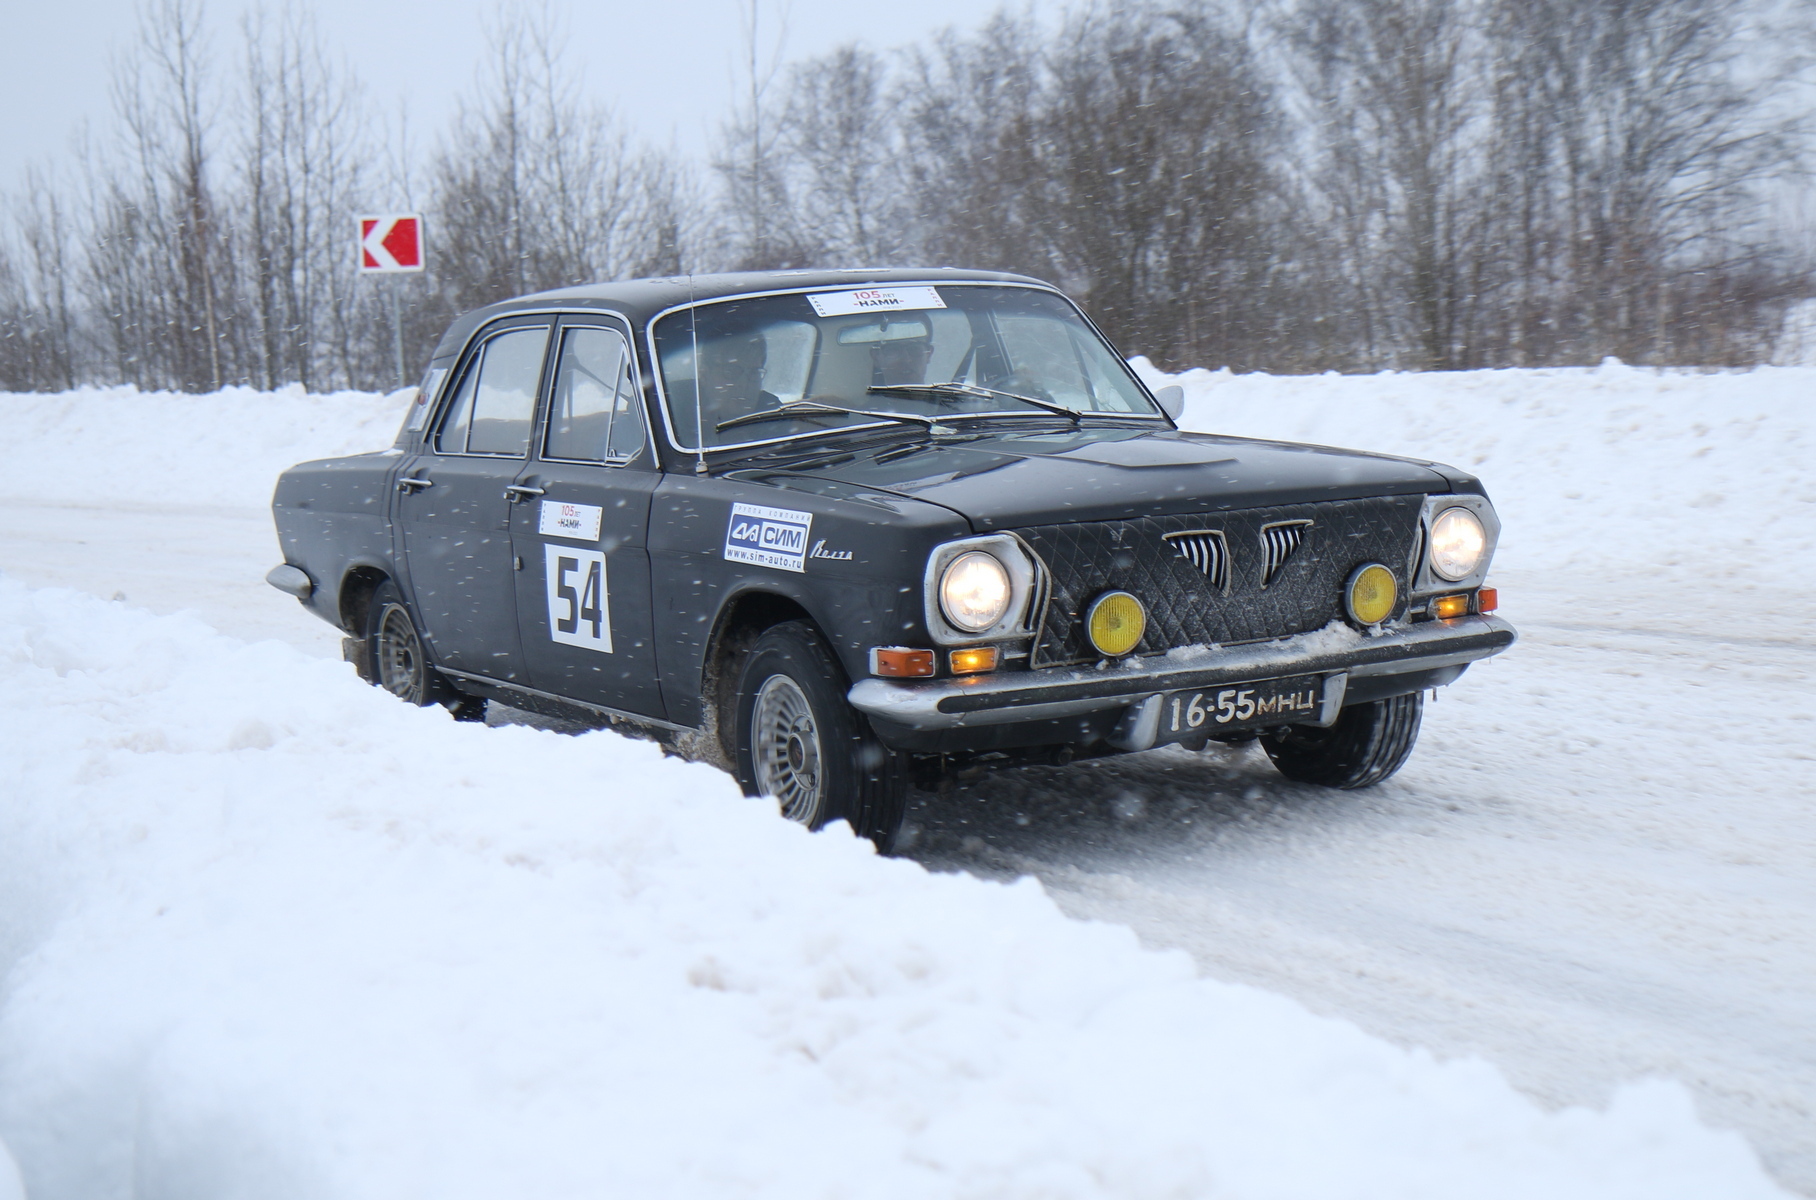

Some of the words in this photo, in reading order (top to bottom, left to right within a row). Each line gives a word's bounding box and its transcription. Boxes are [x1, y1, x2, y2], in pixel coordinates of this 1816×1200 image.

[853, 290, 881, 300] 105
[561, 505, 575, 517] 105
[764, 526, 802, 549] СИМ
[727, 549, 802, 569] www.sim-auto.ru
[557, 556, 602, 640] 54
